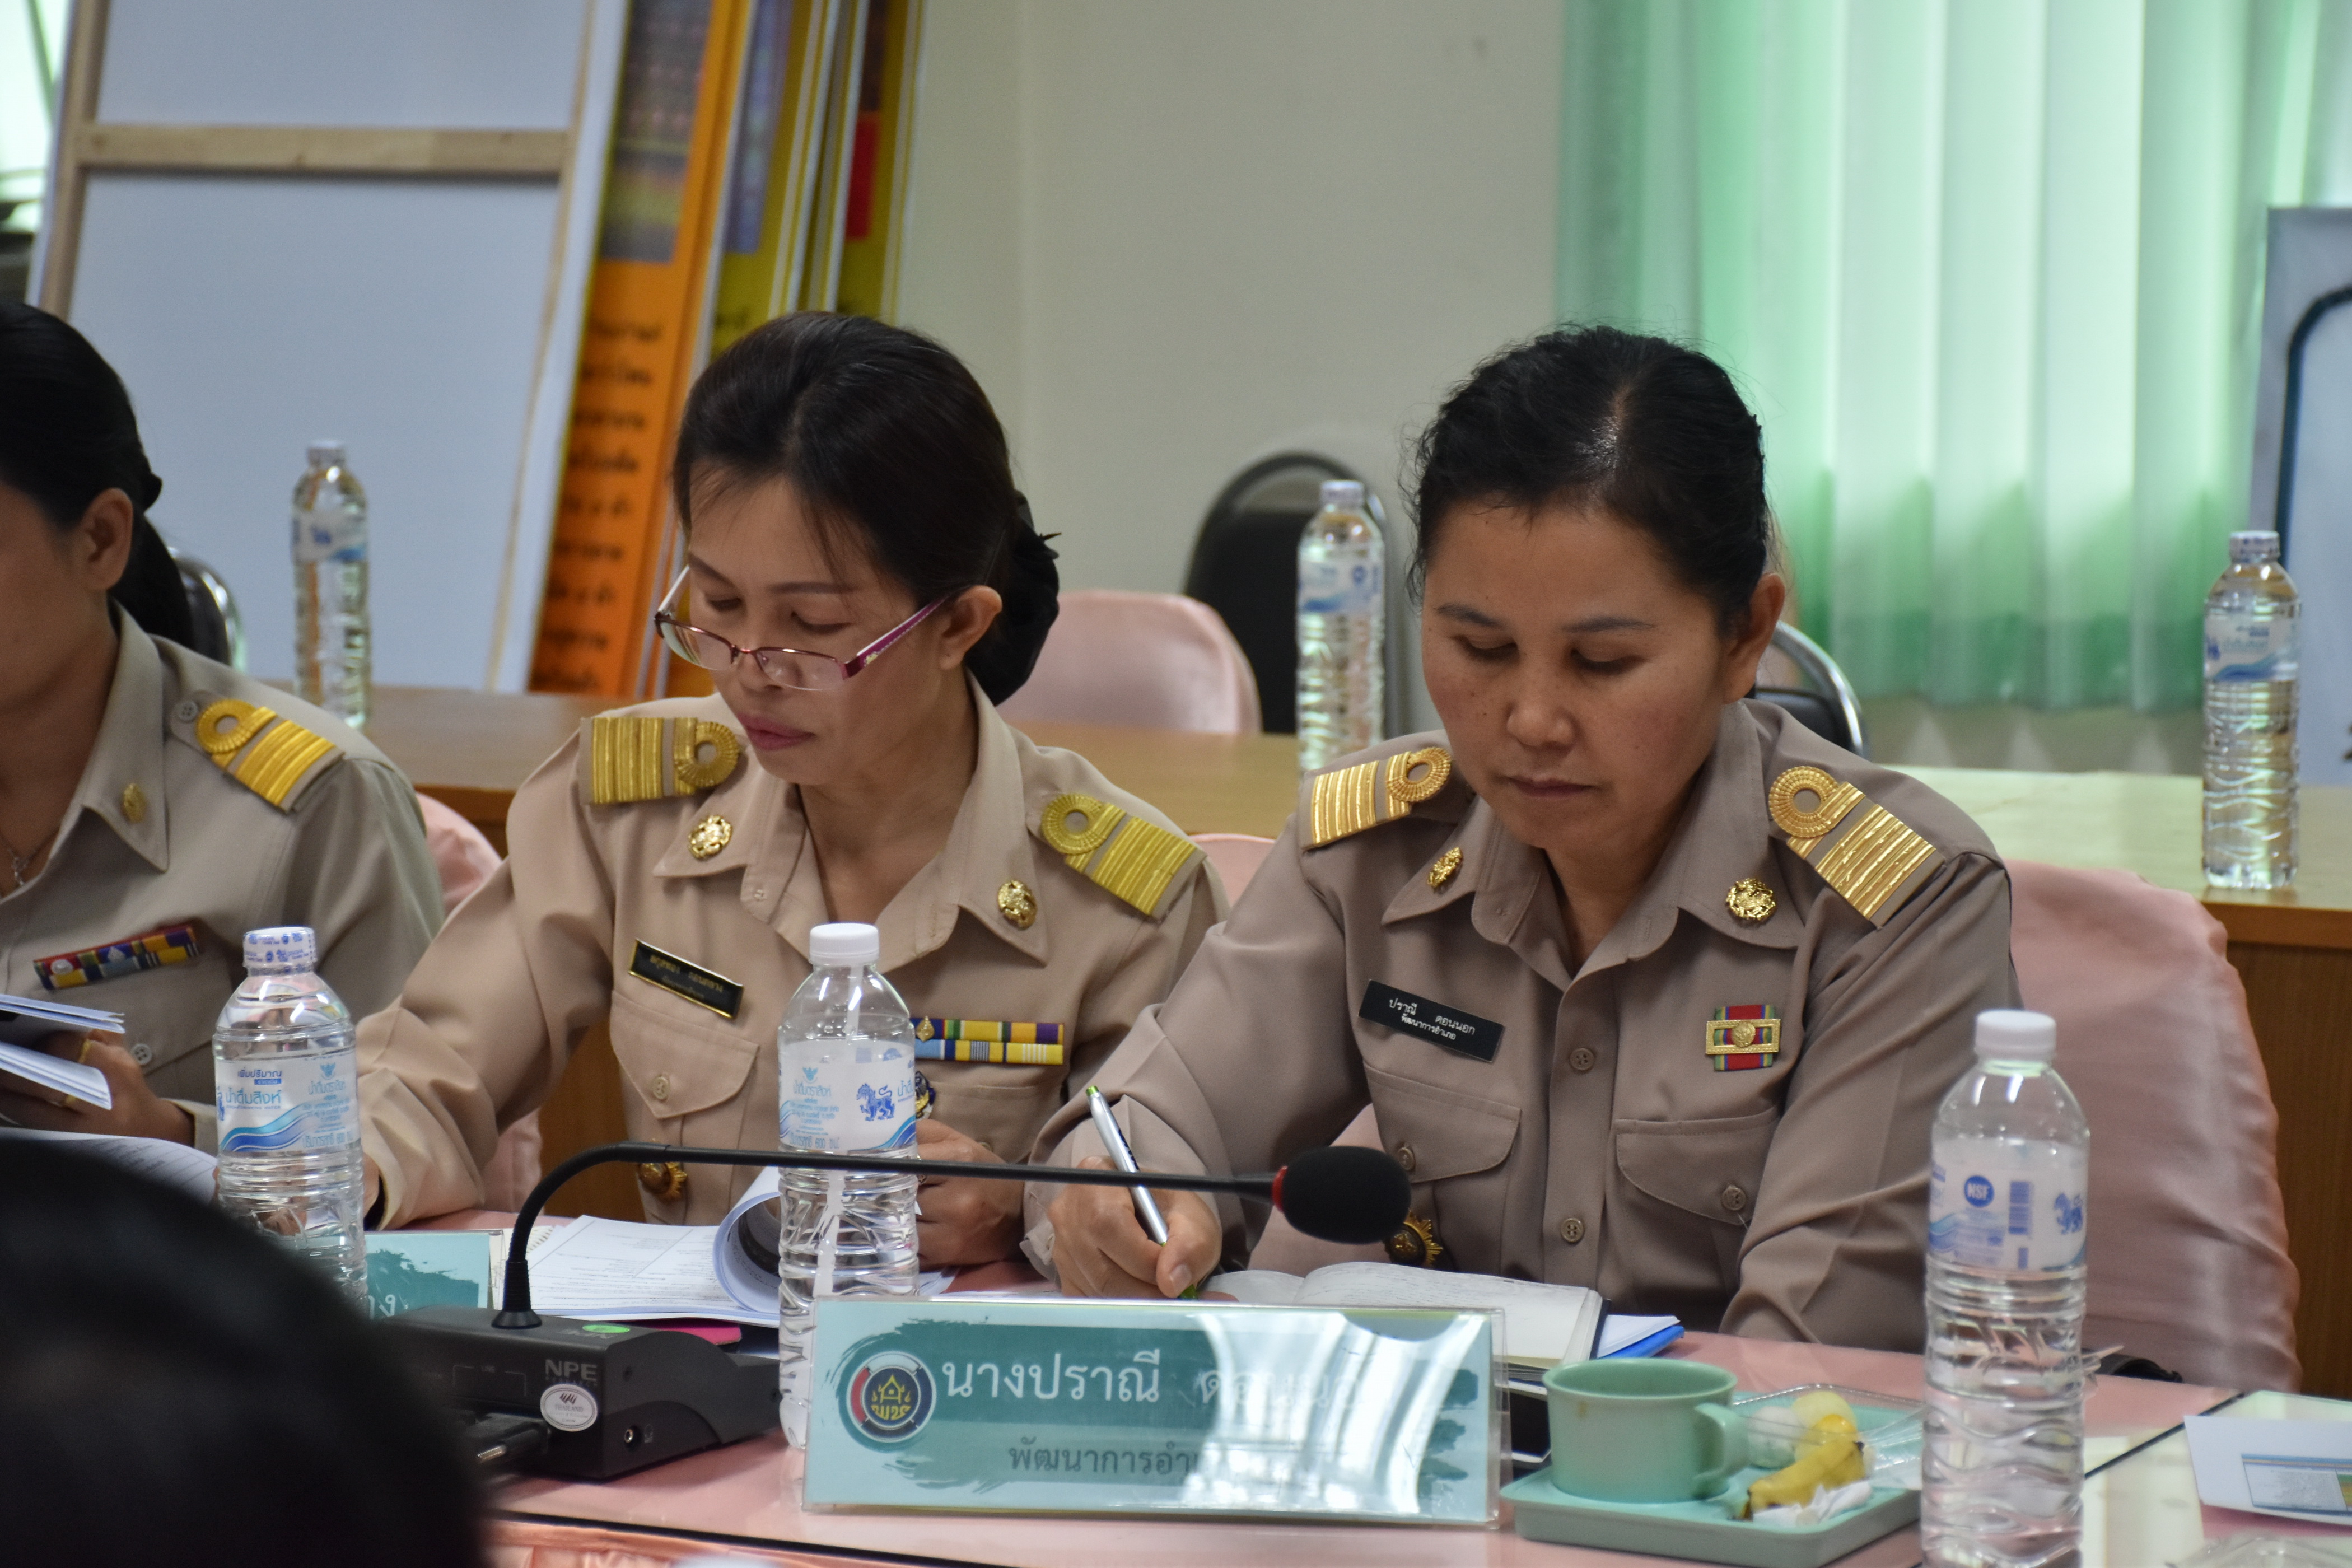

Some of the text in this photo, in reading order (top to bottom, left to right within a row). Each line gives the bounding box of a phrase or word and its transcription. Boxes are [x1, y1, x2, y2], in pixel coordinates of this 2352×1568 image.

[1389, 998, 1417, 1015] ปราณี
[1967, 1182, 1989, 1200] NSF
[545, 1359, 598, 1382] NPE
[942, 1348, 1160, 1402] นางปราณี
